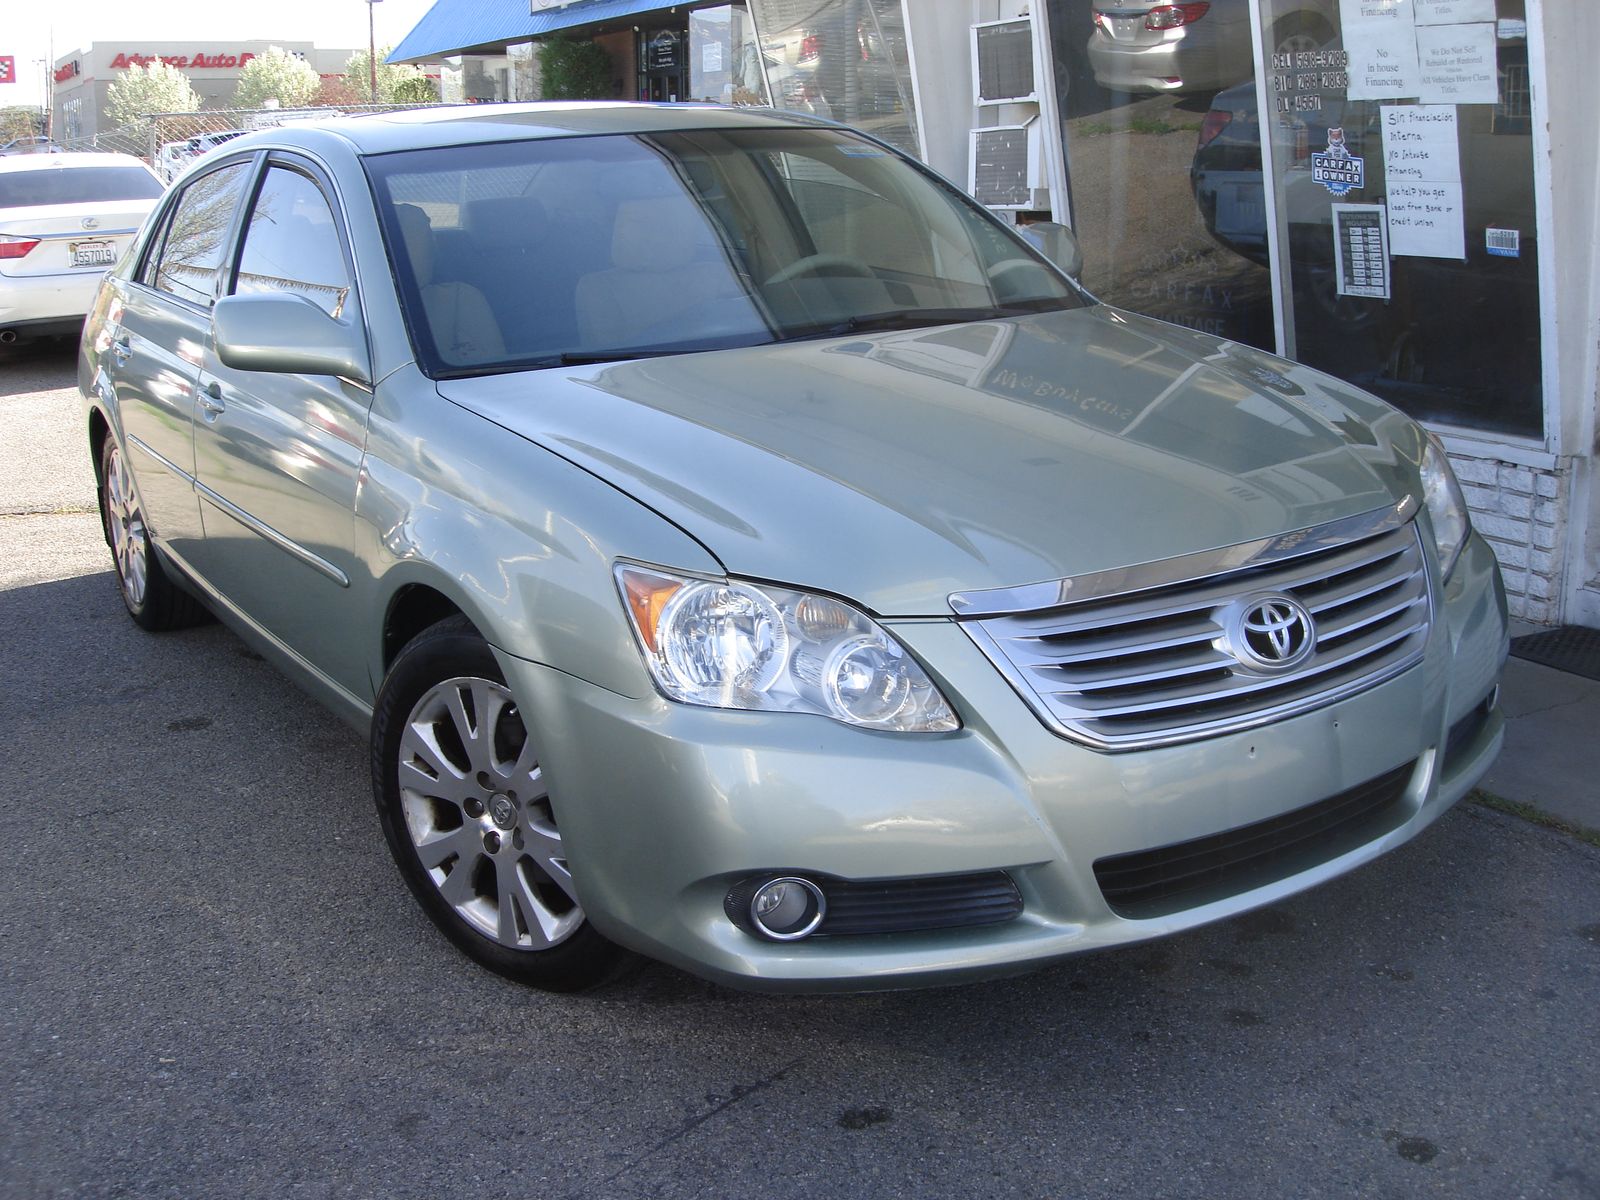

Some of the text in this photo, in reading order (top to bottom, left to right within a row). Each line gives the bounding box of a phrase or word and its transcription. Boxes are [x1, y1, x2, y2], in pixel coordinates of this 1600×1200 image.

[1376, 49, 1388, 58] No
[1451, 46, 1462, 54] Not
[190, 53, 237, 68] Auto
[1272, 53, 1291, 69] CEL
[1367, 63, 1399, 72] in house
[1365, 77, 1404, 88] Financing
[1388, 112, 1405, 125] Sin
[1315, 158, 1360, 173] CARFAX
[1316, 169, 1360, 183] 1 OWNER
[74, 250, 111, 264] 4557019
[1131, 281, 1233, 310] CARFAX
